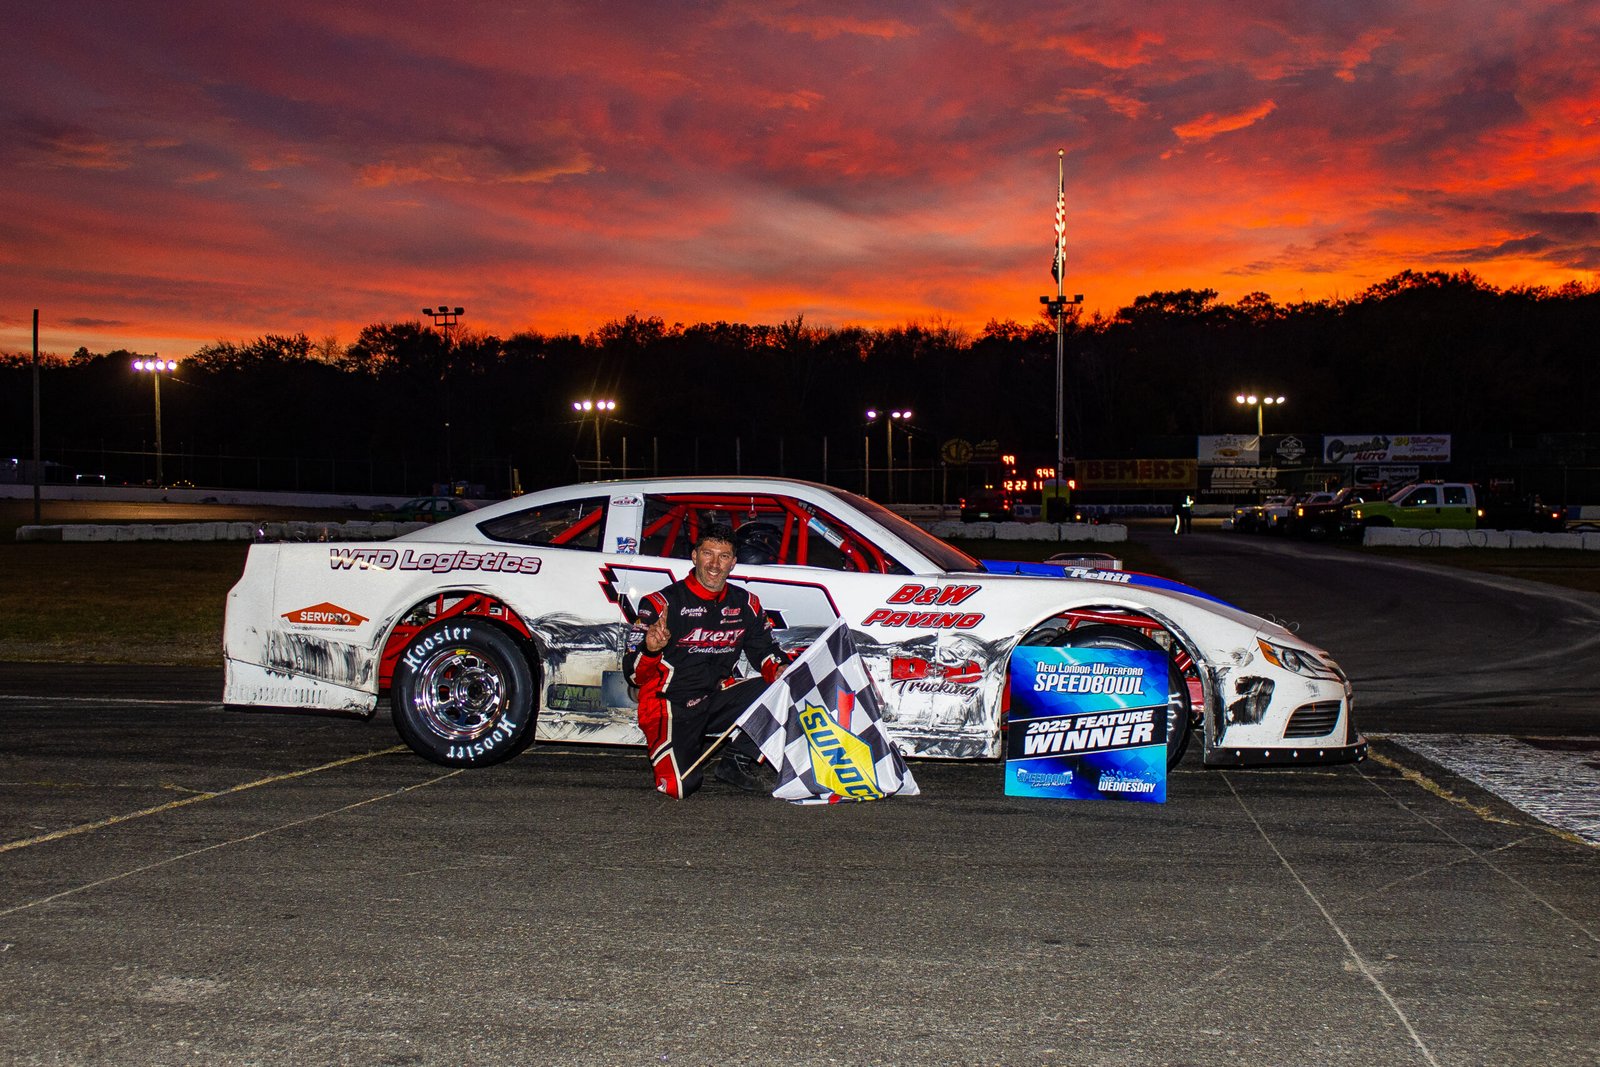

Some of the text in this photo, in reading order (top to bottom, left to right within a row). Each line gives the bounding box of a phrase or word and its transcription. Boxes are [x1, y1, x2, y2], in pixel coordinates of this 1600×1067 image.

[1002, 455, 1015, 465] 99
[1353, 452, 1387, 461] AUTO
[1086, 460, 1187, 481] BEMERS
[1211, 466, 1278, 479] MONACO
[330, 548, 542, 574] WTD Logistics
[1070, 568, 1132, 583] Pettit
[886, 583, 982, 606] B&W
[300, 611, 351, 623] SERVPRO
[861, 608, 985, 629] PAVING
[680, 627, 746, 645] Avery
[402, 625, 472, 674] Hoosier
[687, 645, 735, 654] Construction
[891, 678, 980, 704] Trucking
[1033, 673, 1144, 695] SPEEDBOWL
[1026, 709, 1154, 734] 2025 FEATURE
[446, 712, 517, 761] Hoosier
[1023, 722, 1155, 756] WINNER
[1098, 781, 1156, 793] WEDNESDAY
